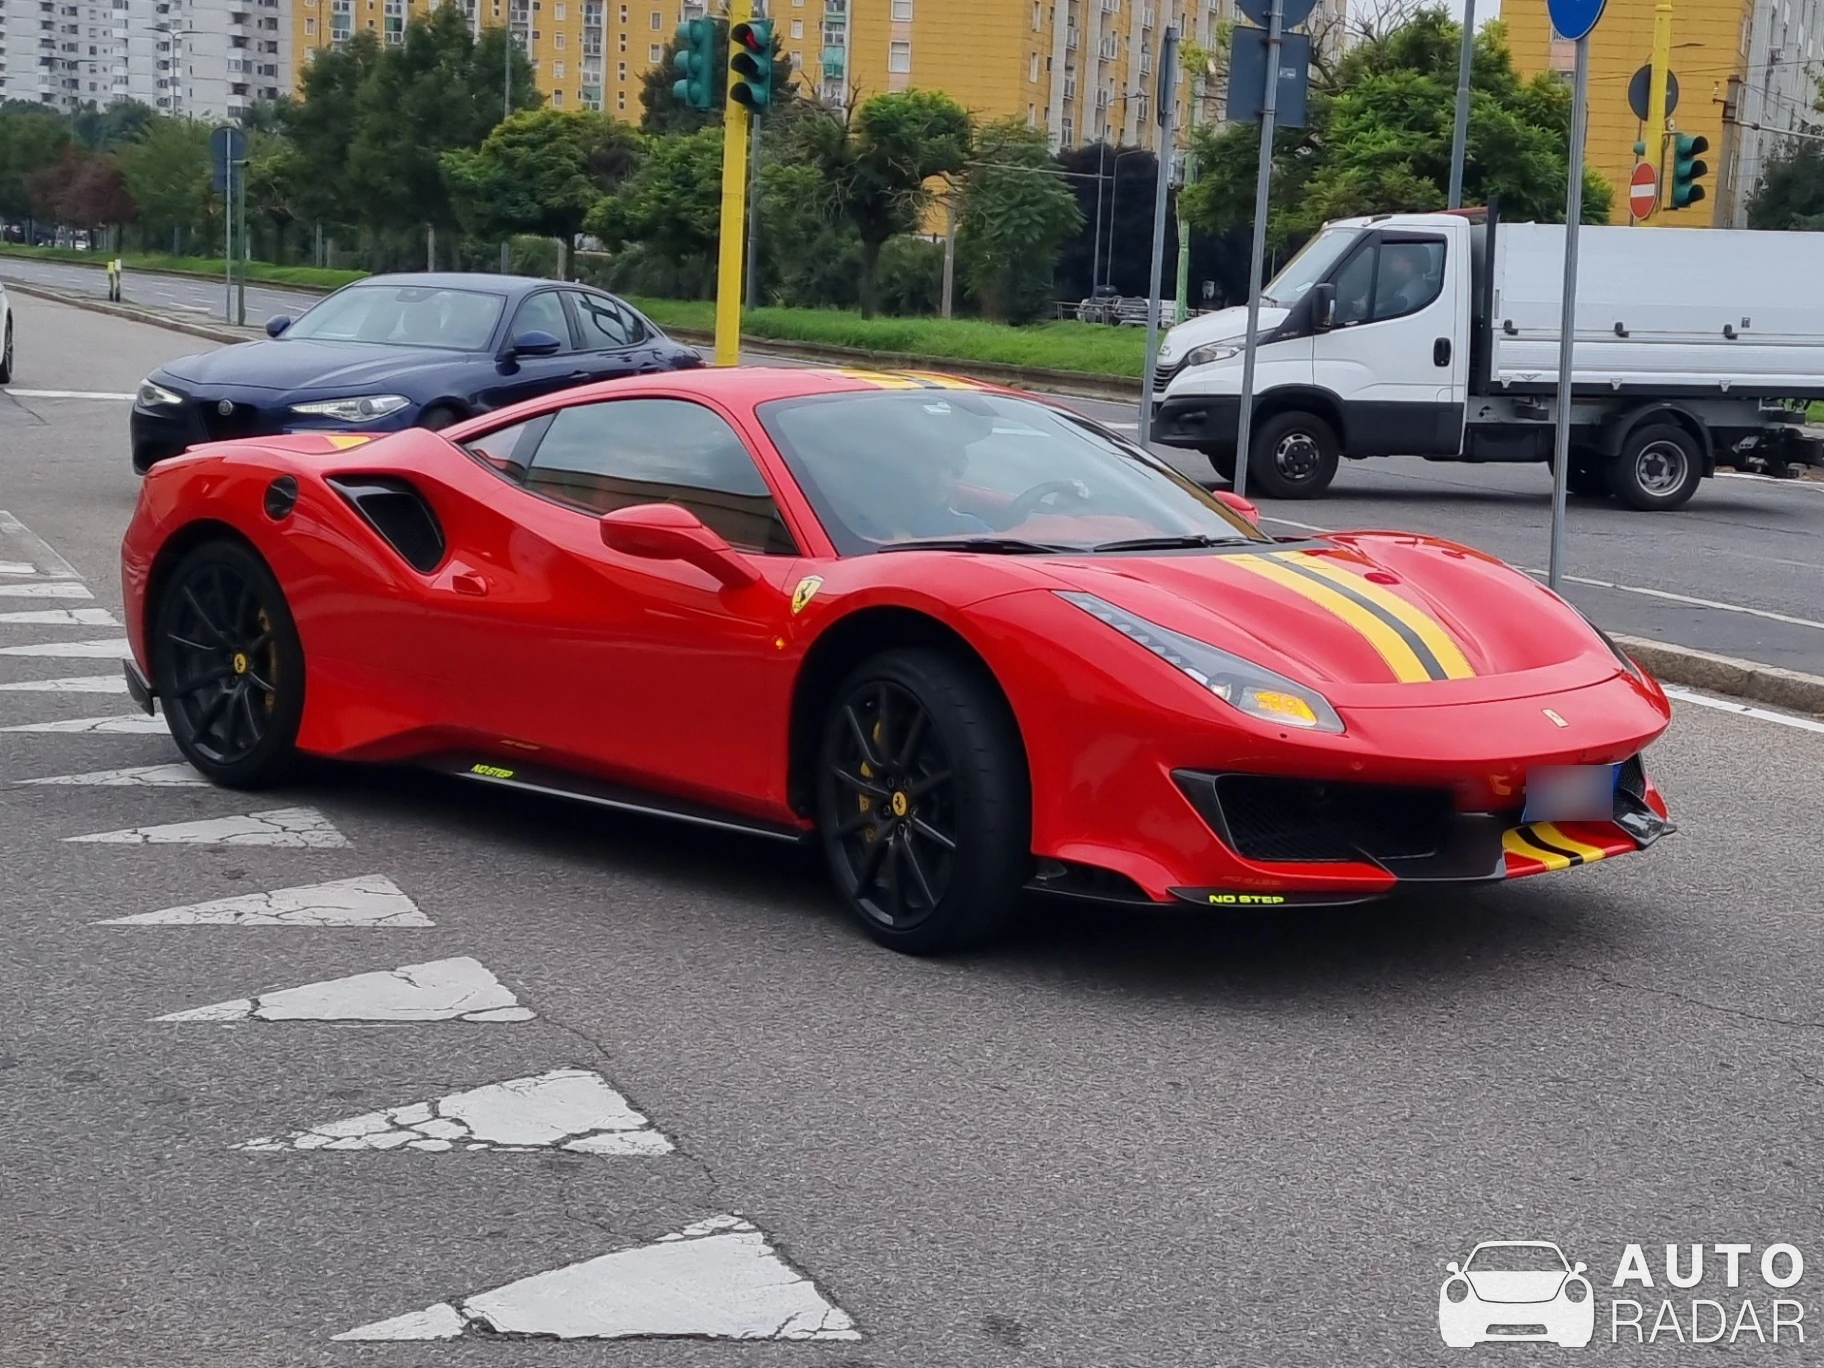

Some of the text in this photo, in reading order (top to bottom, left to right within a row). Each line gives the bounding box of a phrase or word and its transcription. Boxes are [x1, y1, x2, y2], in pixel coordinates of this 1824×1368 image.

[470, 763, 514, 778] NO STEP
[1208, 894, 1285, 904] NO STEP
